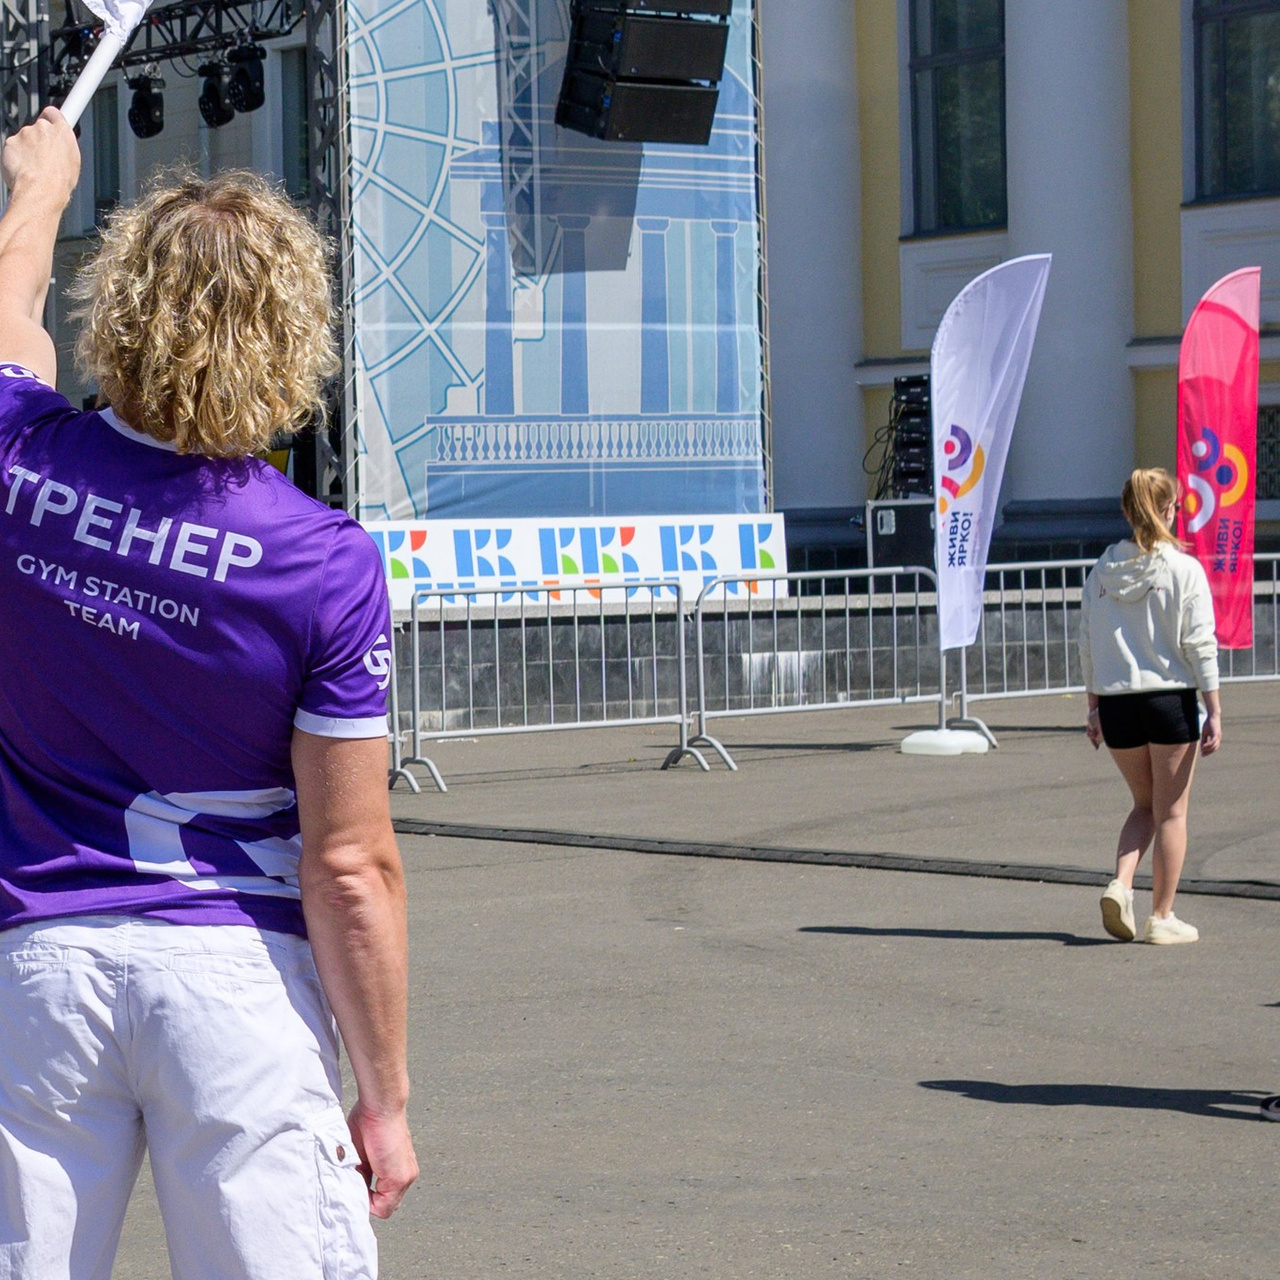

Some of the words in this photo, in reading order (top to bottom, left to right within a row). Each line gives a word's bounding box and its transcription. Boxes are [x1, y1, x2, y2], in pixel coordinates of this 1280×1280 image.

[5, 465, 264, 583] ТРЕНЕР
[948, 511, 961, 568] ЖИВИ
[958, 512, 973, 567] ЯРКО!
[1213, 518, 1230, 573] ЖИВИ
[1228, 520, 1243, 573] ЯРКО!
[16, 553, 78, 590] GYM
[82, 576, 200, 627] STATION
[63, 599, 141, 640] TEAM
